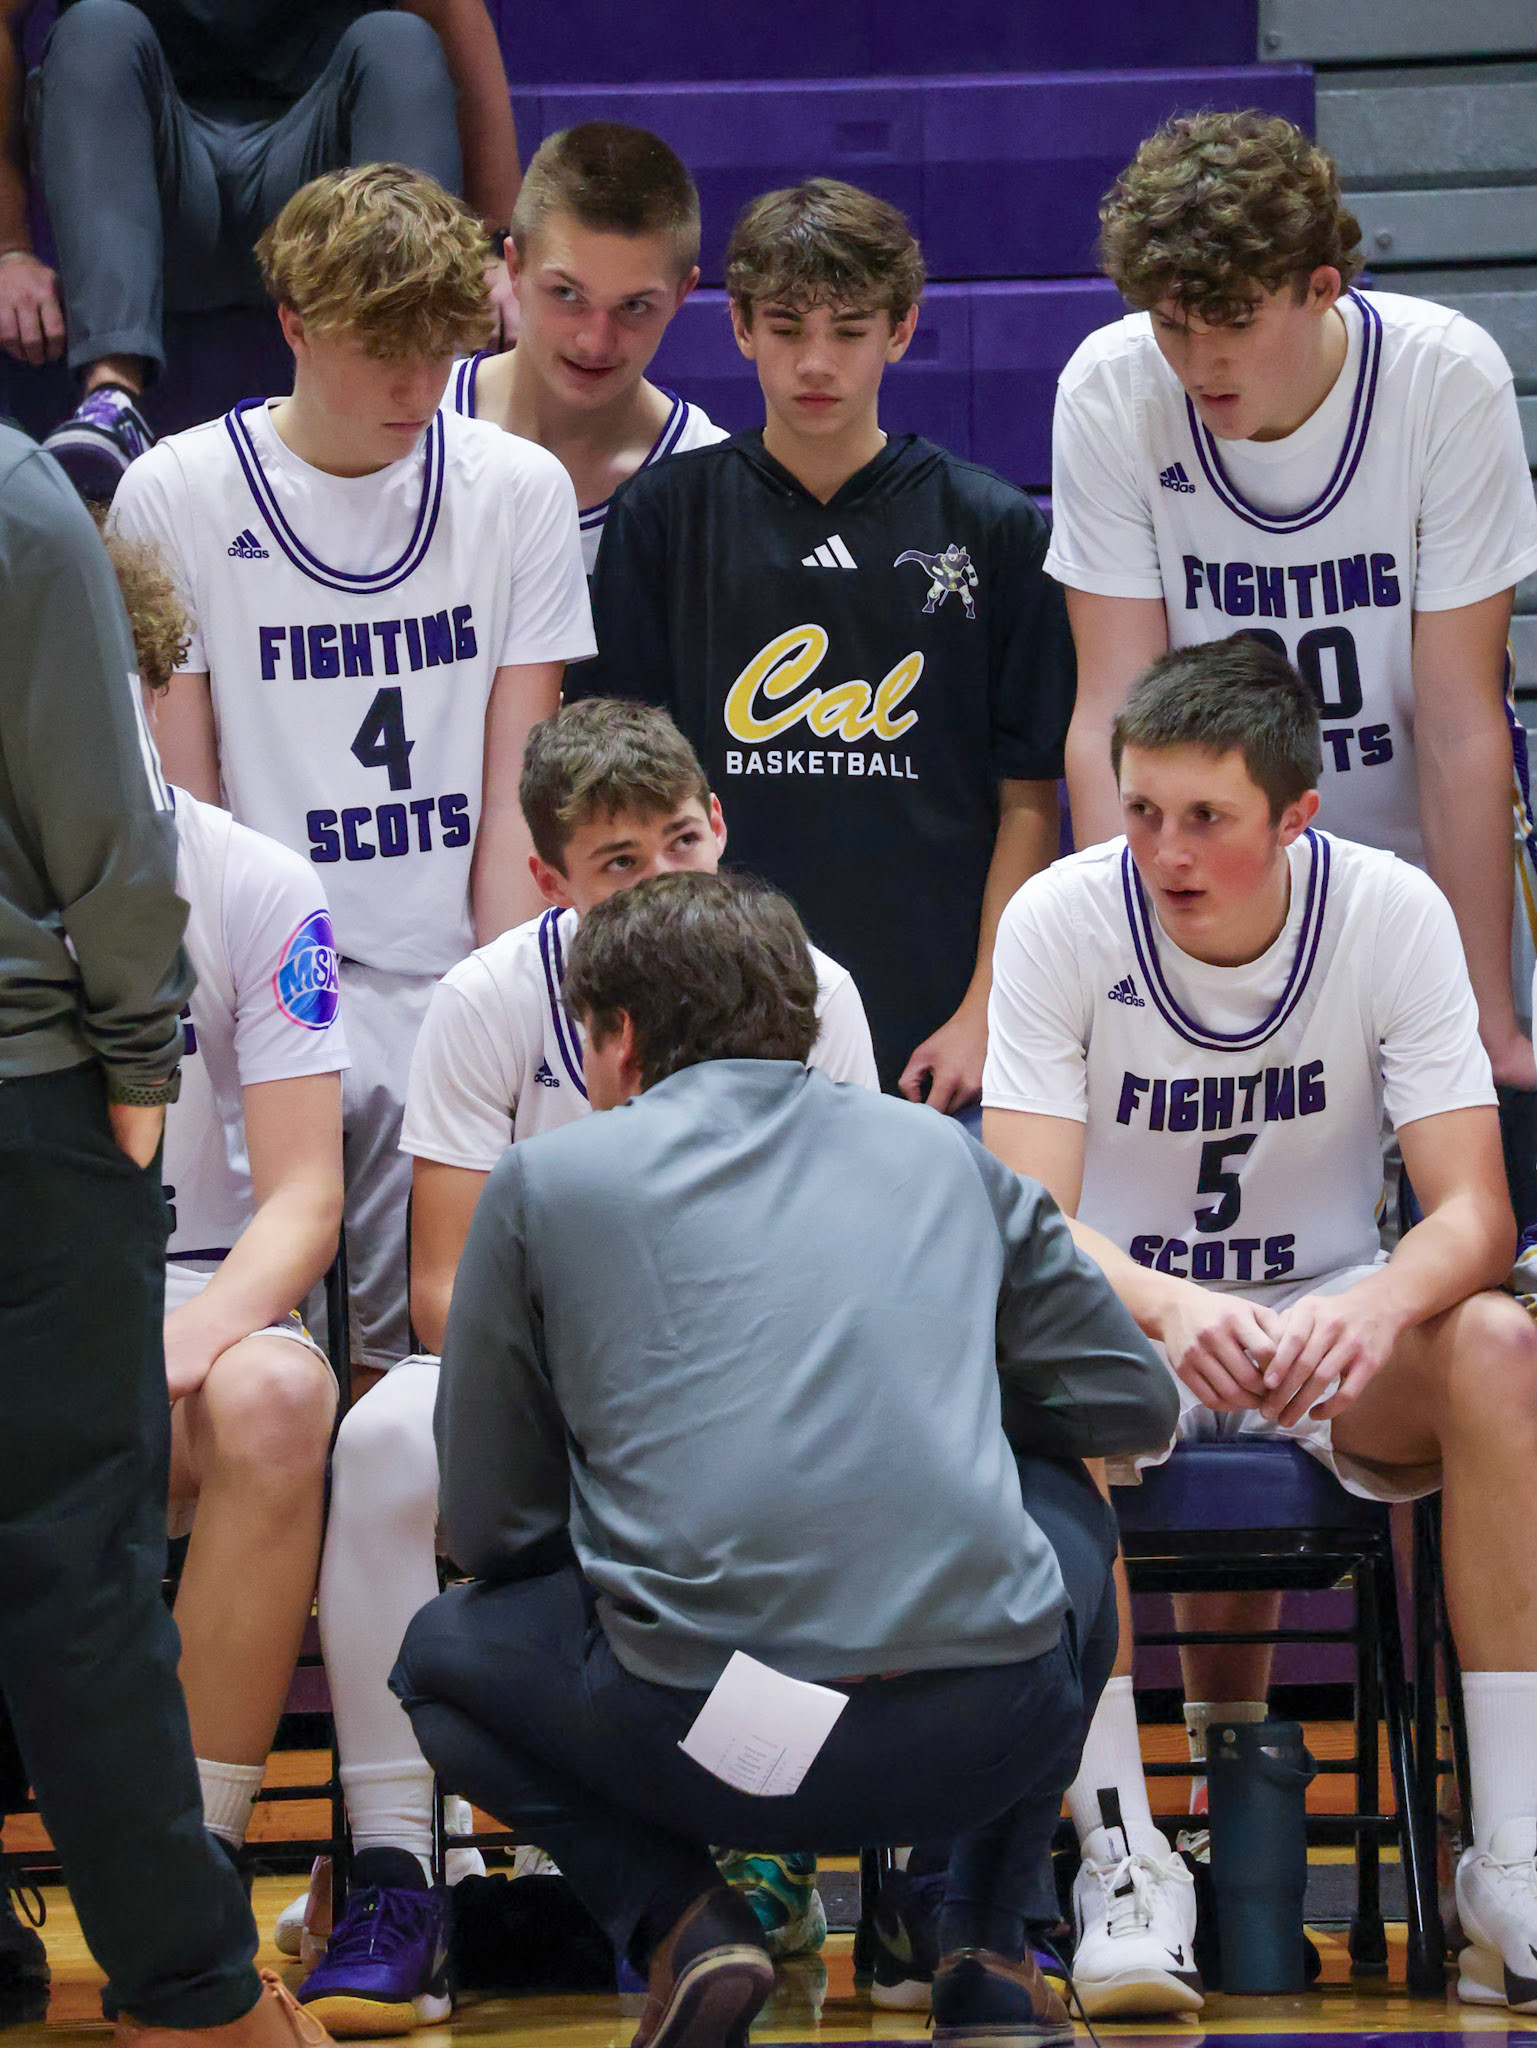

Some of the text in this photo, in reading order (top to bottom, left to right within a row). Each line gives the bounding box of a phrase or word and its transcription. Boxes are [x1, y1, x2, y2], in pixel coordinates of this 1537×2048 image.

[227, 547, 270, 559] adidas
[1182, 553, 1401, 618] FIGHTING
[258, 604, 478, 681] FIGHTING
[1228, 626, 1363, 720] 0
[724, 623, 925, 744] Cal
[350, 686, 416, 792] 4
[726, 750, 919, 780] BASKETBALL
[306, 793, 471, 863] SCOTS
[1194, 1133, 1258, 1233] 5
[1129, 1233, 1296, 1281] SCOTS
